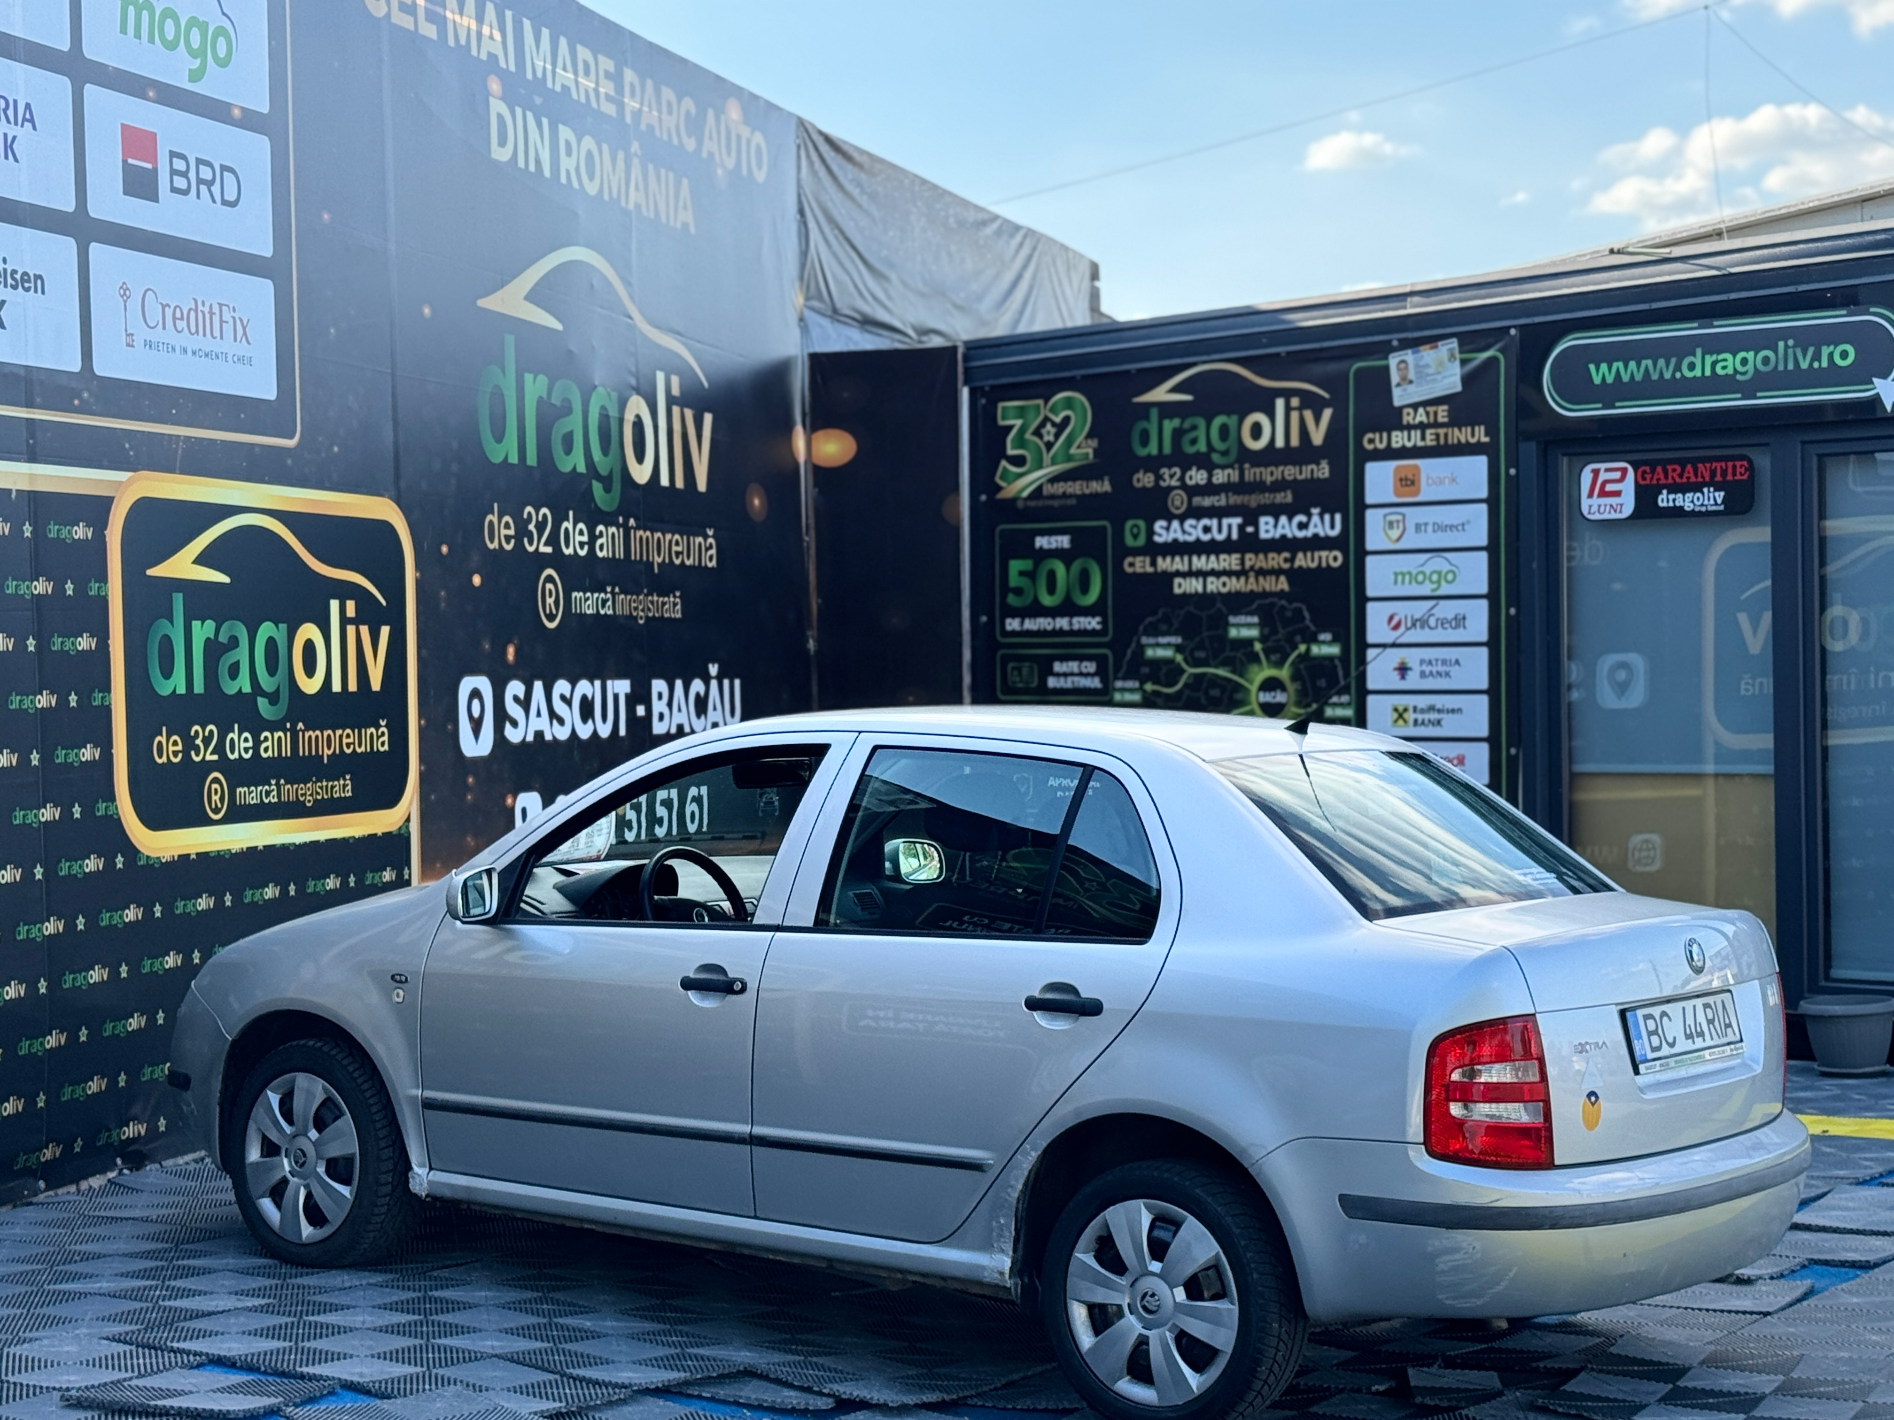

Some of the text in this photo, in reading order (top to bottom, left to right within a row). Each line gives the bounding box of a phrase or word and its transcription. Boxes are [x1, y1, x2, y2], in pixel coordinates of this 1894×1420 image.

[119, 0, 233, 83] mogo
[445, 0, 516, 73] MAI
[522, 17, 618, 118] MARE
[623, 66, 697, 153] PARC
[702, 107, 769, 184] AUTO
[168, 149, 242, 209] BRD
[488, 96, 696, 235] DIN ROMÂNIA
[140, 287, 252, 345] CreditFix
[143, 338, 253, 366] PRIETEN IN MOMENTE CHEIE
[1587, 339, 1855, 385] www.dragoliv.ro
[477, 334, 714, 512] dragoliv
[1402, 405, 1449, 425] RATE
[1131, 397, 1334, 465] dragoliv
[1362, 425, 1490, 450] CU BULETINUL
[1132, 459, 1330, 488] de 32 de ani împreună
[1398, 473, 1459, 487] tbi bank
[1586, 466, 1629, 499] 12
[1636, 460, 1750, 485] GARANTIE
[1587, 503, 1625, 516] LUNI
[1657, 487, 1725, 511] dragoliv
[46, 521, 94, 544] dragoliv
[484, 502, 718, 574] de 32 de ani împreună
[1152, 516, 1243, 543] SASCUT
[1258, 507, 1342, 540] BACĂU
[1414, 523, 1429, 534] BT
[1034, 534, 1071, 549] PESTE
[1123, 550, 1343, 574] CEL MAI MARE PARC AUTO
[4, 577, 54, 599] dragoliv
[1006, 557, 1102, 608] 500
[1173, 572, 1290, 594] DIN ROMÂNIA
[1392, 568, 1458, 593] mogo
[571, 586, 614, 616] marcă
[615, 587, 682, 624] înregistrată
[1004, 616, 1103, 631] DE AUTO PE STOC
[1404, 613, 1467, 631] UniCredit
[51, 633, 98, 655] dragoliv
[147, 593, 391, 721] dragoliv
[1419, 658, 1462, 668] PATRIA
[1419, 669, 1452, 679] BANK
[8, 690, 57, 713] dragoliv
[504, 679, 631, 744] SASCUT
[651, 663, 742, 735] BACĂU
[54, 744, 100, 766] dragoliv
[153, 719, 390, 764] de 32 de ani împreună
[236, 781, 278, 806] marcă
[281, 775, 352, 806] înregistrată
[12, 803, 61, 827] dragoliv
[654, 788, 678, 838] 51
[685, 785, 709, 834] 61
[58, 854, 104, 878] dragoliv
[16, 917, 65, 941] dragoliv
[99, 904, 143, 928] dragoliv
[174, 893, 215, 916] dragoliv
[243, 883, 281, 904] dragoliv
[61, 964, 109, 989] dragoliv
[141, 951, 182, 974] dragoliv
[1642, 1010, 1677, 1053] BC
